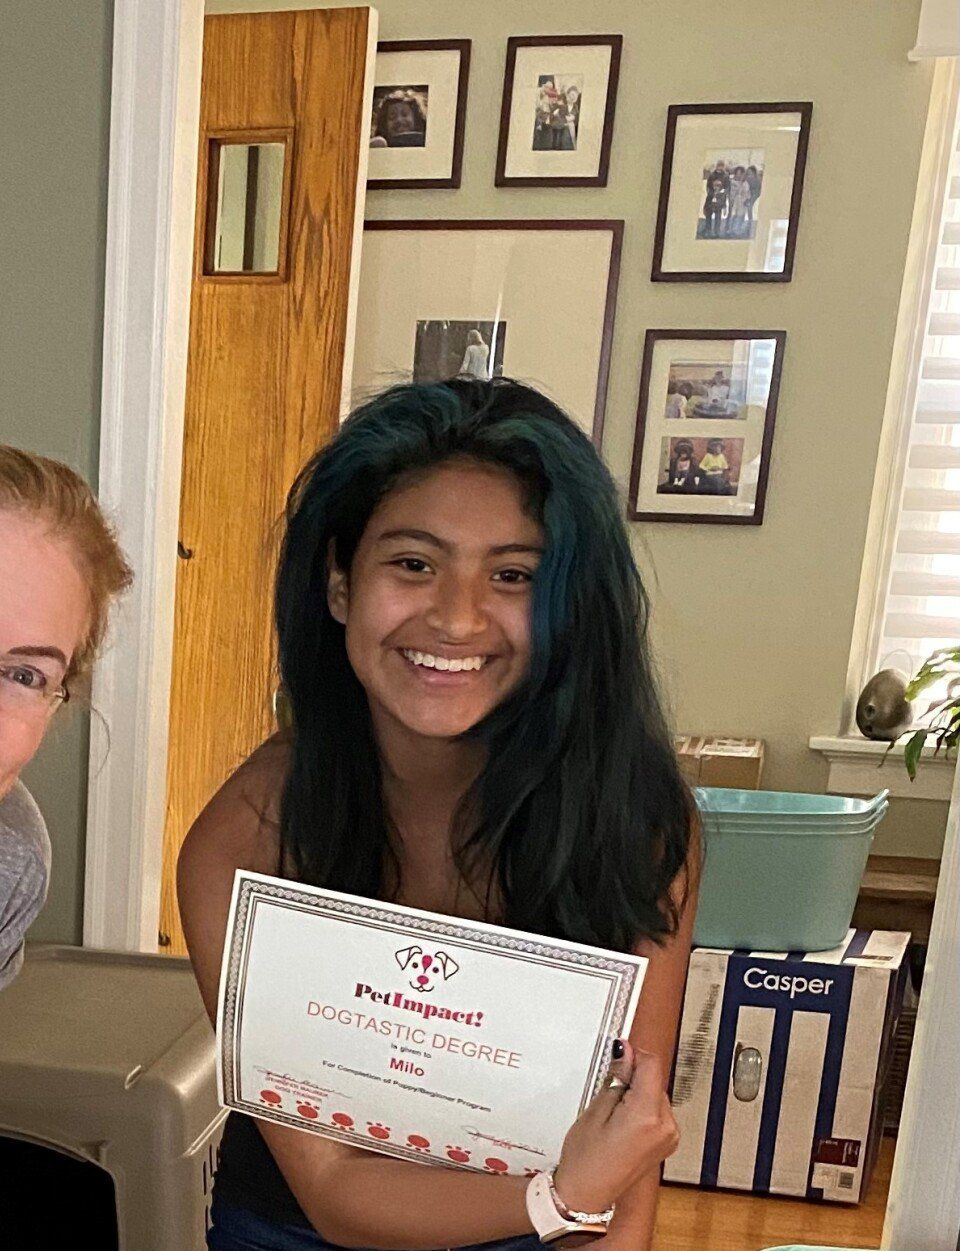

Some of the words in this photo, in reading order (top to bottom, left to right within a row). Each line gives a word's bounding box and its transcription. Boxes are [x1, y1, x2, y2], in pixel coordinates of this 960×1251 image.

[743, 967, 834, 999] Casper
[354, 982, 484, 1027] PetImpact!
[306, 1001, 426, 1044] DOGTASTIC
[431, 1033, 523, 1069] DEGREE
[400, 1046, 422, 1056] given
[424, 1051, 432, 1059] to
[390, 1057, 425, 1077] Milo
[322, 1060, 335, 1069] For
[337, 1064, 382, 1082] Completion
[456, 1098, 492, 1113] Program
